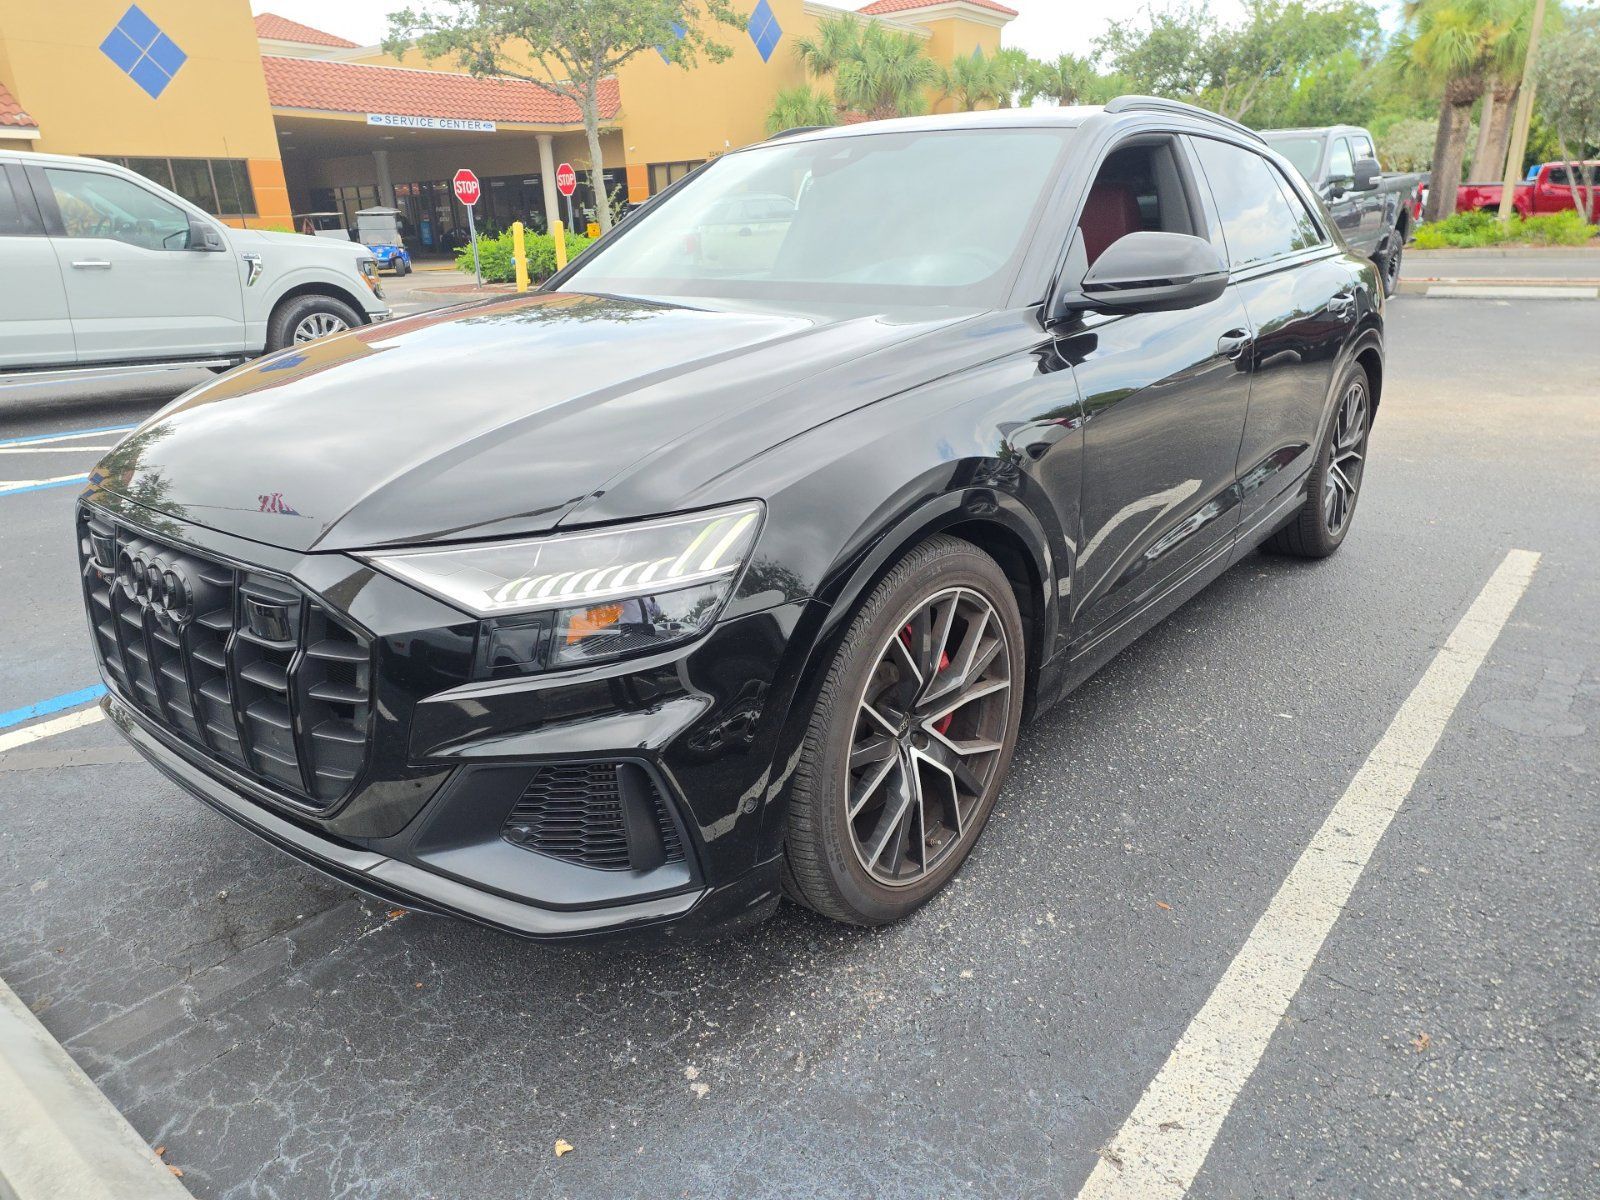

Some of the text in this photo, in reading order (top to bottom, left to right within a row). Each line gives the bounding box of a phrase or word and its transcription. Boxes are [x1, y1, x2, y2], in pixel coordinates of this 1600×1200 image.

[384, 115, 434, 127] SERVICE
[439, 119, 481, 129] CENTER
[456, 180, 477, 194] STOP
[556, 173, 574, 187] STOP
